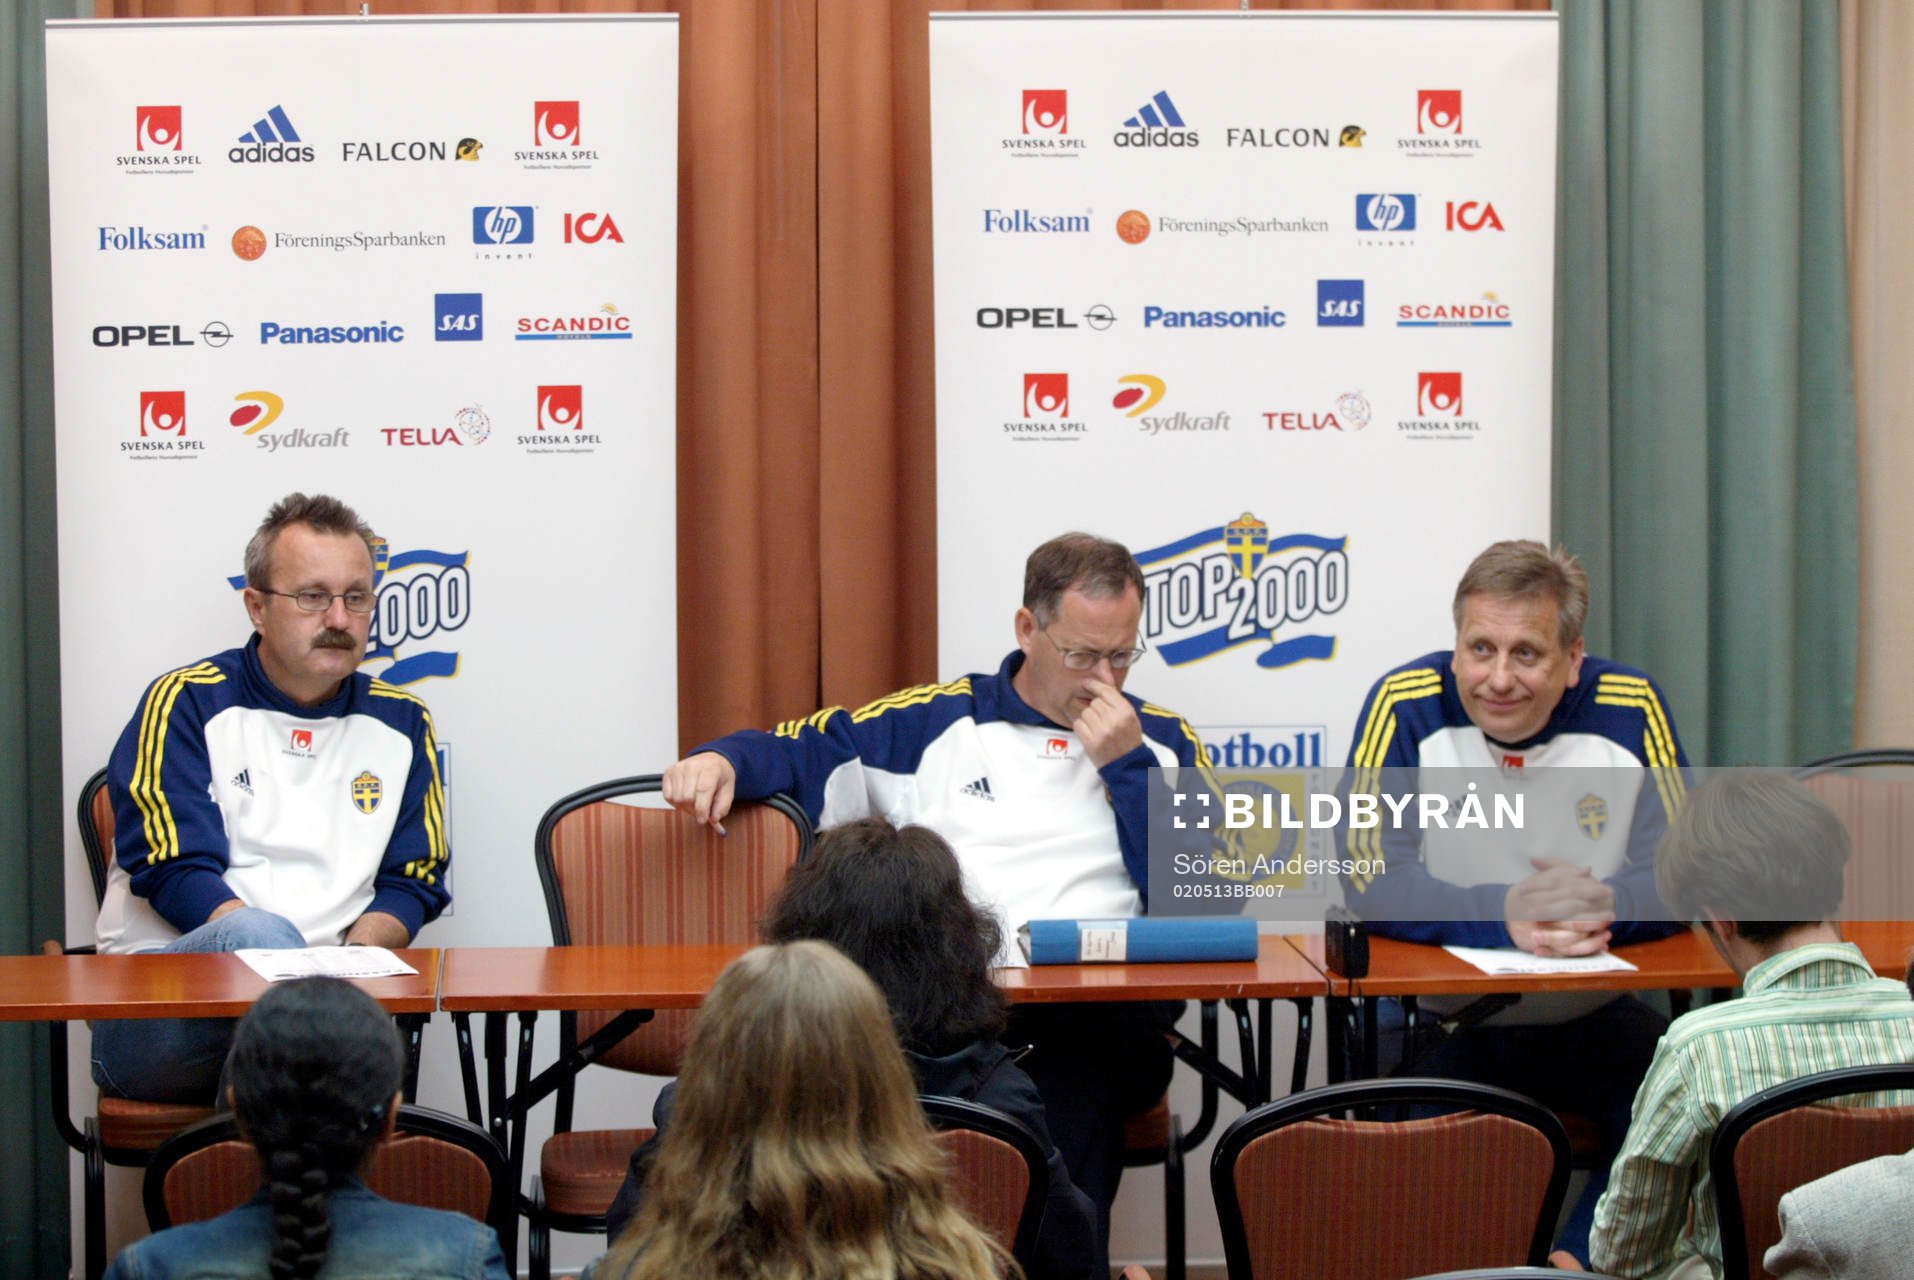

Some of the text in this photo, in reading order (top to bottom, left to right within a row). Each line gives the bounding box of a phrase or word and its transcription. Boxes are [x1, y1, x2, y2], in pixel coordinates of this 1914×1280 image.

[1002, 139, 1086, 148] SVENSKA SPEL
[1114, 127, 1199, 147] adidas
[1227, 128, 1329, 147] FALCON
[1398, 139, 1480, 148] SVENSKA SPEL
[117, 156, 201, 165] SVENSKA SPEL
[228, 142, 315, 163] adidas
[343, 142, 445, 161] FALCON
[515, 151, 599, 160] SVENSKA SPEL
[984, 209, 1089, 232] Folksam
[1446, 201, 1504, 232] ICA
[564, 213, 624, 244] ICA
[1159, 217, 1328, 236] FöreningsSparbanken
[99, 227, 205, 250] Folksam
[275, 232, 445, 251] FöreningsSparbanken
[977, 308, 1078, 328] OPEL
[1144, 306, 1286, 328] Panasonic
[1320, 299, 1362, 318] SAS
[1400, 305, 1509, 319] SCANDIC
[261, 321, 404, 344] Panasonic
[438, 314, 480, 332] SAS
[518, 317, 630, 332] SCANDIC
[93, 325, 194, 347] OPEL
[1004, 423, 1087, 432] SVENSKA SPEL
[1139, 411, 1231, 435] sydkraft
[1262, 413, 1343, 431] TELIA
[1398, 421, 1480, 430] SVENSKA SPEL
[121, 441, 205, 451] SVENSKA SPEL
[256, 427, 349, 452] sydkraft
[381, 428, 463, 446] TELIA
[518, 435, 601, 445] SVENSKA SPEL
[1143, 548, 1349, 643] TOP 2000
[365, 564, 470, 657] 000
[1203, 731, 1321, 768] otboll
